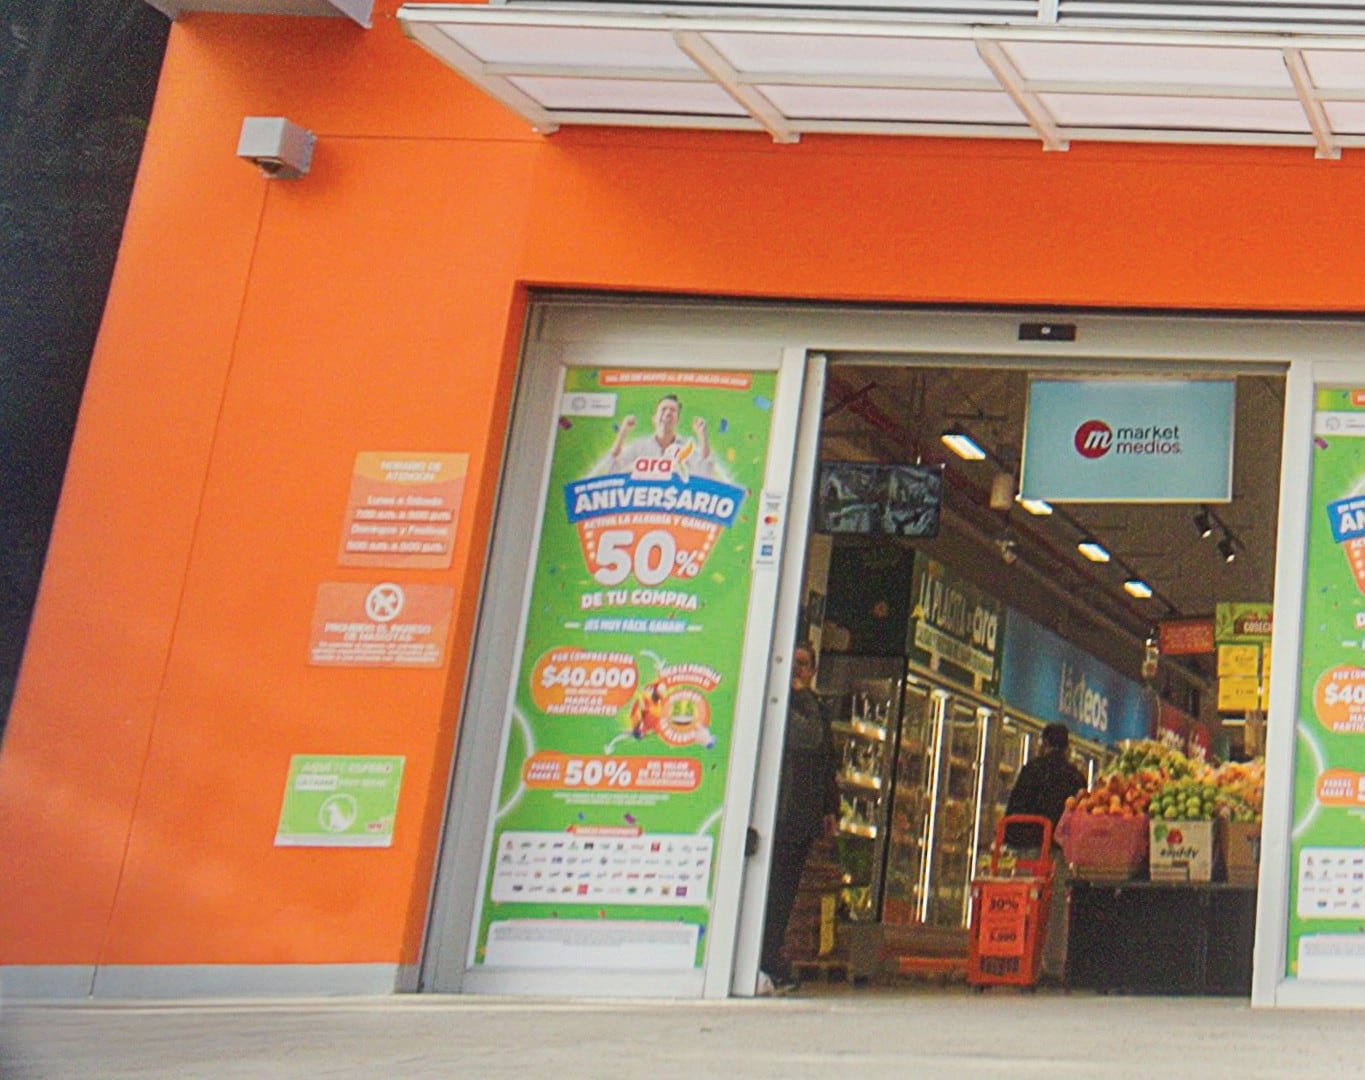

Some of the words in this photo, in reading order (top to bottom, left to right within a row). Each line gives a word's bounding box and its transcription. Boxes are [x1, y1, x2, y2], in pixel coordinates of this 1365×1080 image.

[1117, 425, 1180, 439] market
[1116, 440, 1181, 454] medios
[636, 458, 672, 472] ara
[594, 529, 699, 586] 50%
[581, 592, 603, 609] DE
[606, 590, 628, 605] TU
[631, 589, 697, 610] COMPRA
[973, 607, 997, 651] ara
[541, 663, 636, 689] $40.000
[1059, 662, 1108, 732] lácteos
[563, 759, 632, 787] 50%
